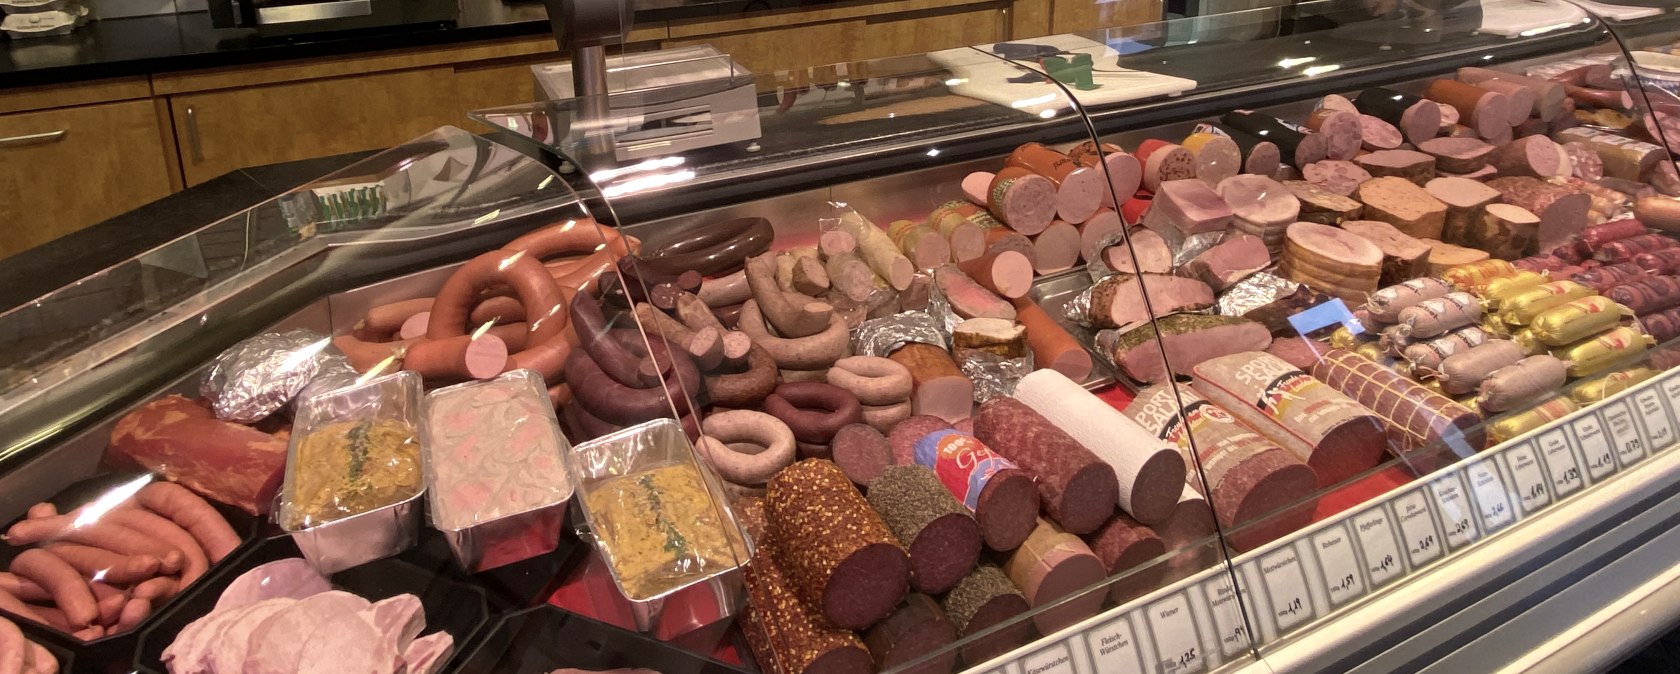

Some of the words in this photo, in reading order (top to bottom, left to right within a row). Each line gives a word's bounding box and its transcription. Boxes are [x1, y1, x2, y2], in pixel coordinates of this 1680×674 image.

[1135, 389, 1172, 427] PORT
[1341, 573, 1355, 591] 1,59
[1160, 607, 1180, 620] Wiener
[1288, 597, 1303, 616] 1,19
[1099, 639, 1129, 657] Würstchen
[1101, 631, 1123, 647] Fleisch-
